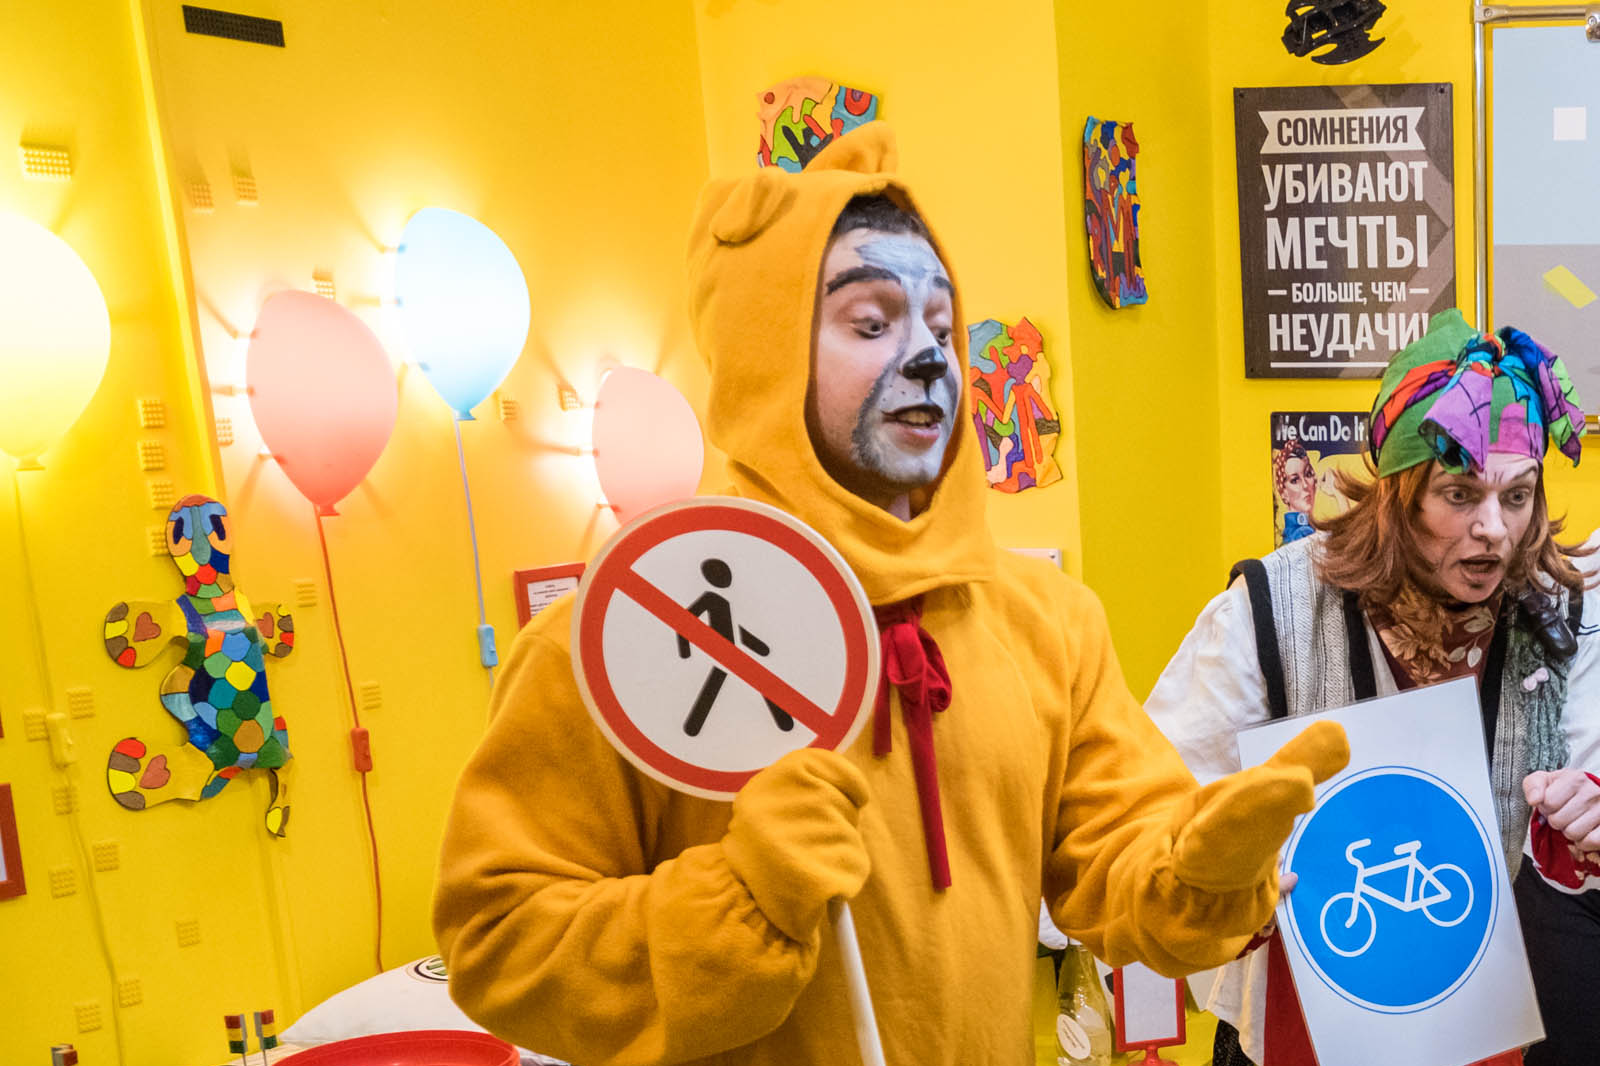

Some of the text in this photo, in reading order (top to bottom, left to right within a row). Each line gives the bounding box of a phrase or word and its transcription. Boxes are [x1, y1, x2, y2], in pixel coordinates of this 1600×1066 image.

[1276, 114, 1409, 147] СОМНЕНИЯ
[1261, 160, 1429, 211] УБИВАЮТ
[1266, 214, 1429, 270] МЕЧТЫ
[1291, 281, 1406, 305] БОЛЬШЕ, ЧЕМ
[1299, 415, 1328, 442] Can
[1329, 415, 1352, 442] Do
